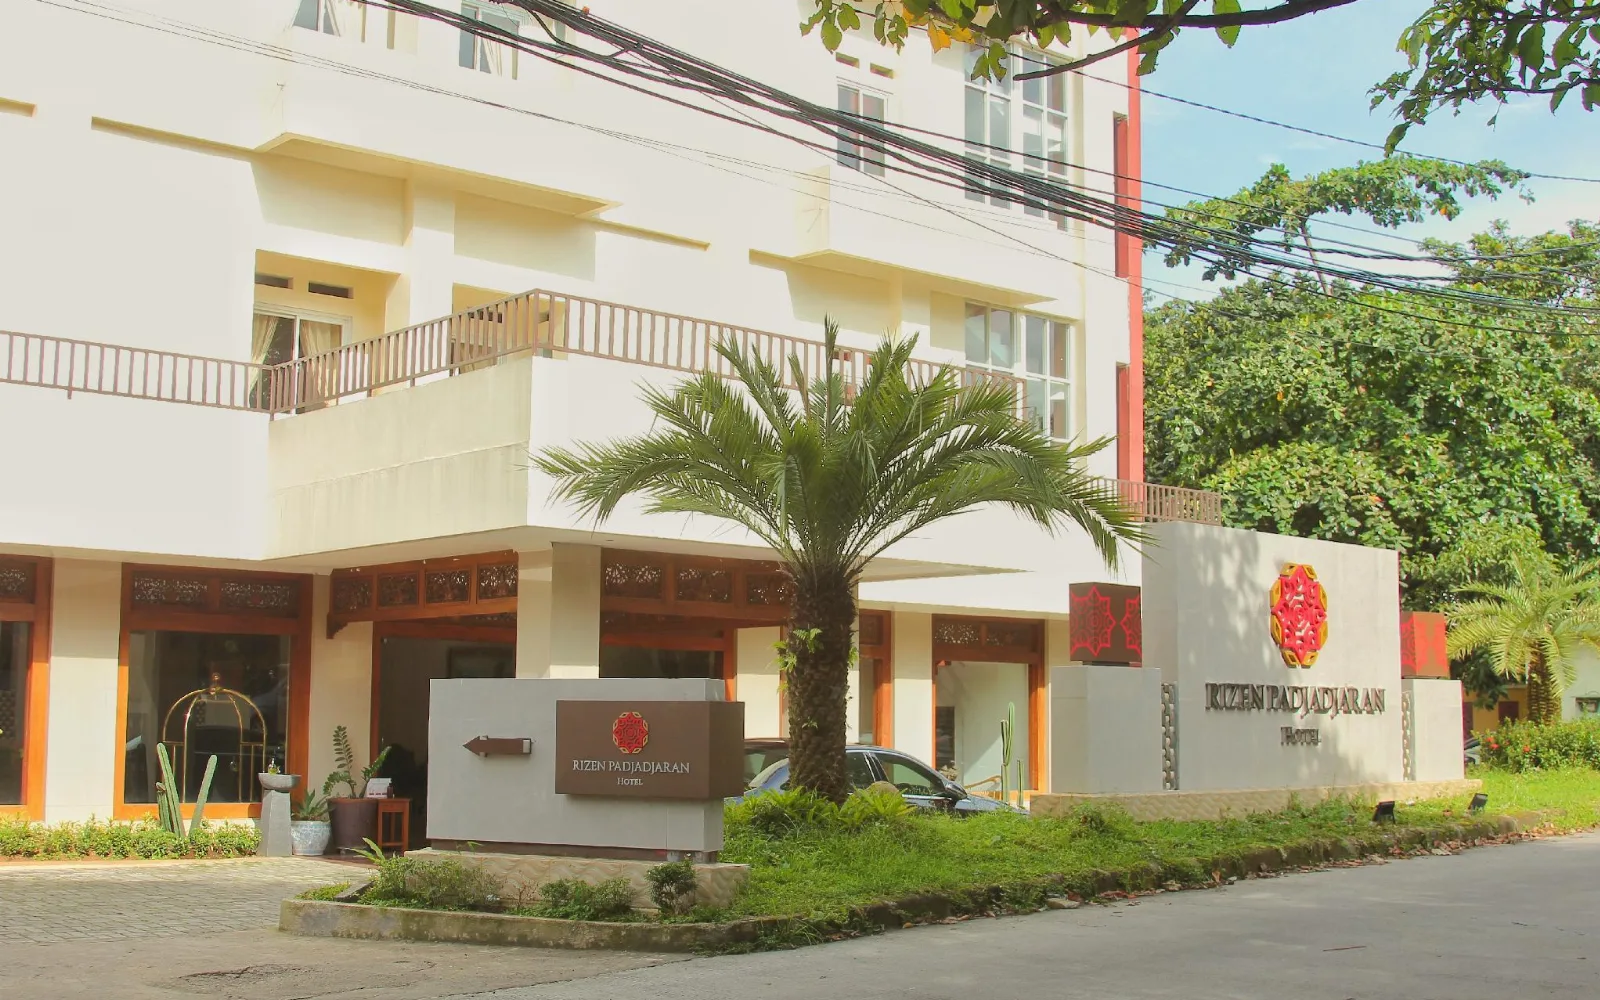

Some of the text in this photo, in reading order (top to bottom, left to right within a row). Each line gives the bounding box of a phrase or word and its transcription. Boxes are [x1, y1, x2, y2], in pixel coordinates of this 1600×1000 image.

[1205, 683, 1386, 720] RIZEN PADJADJARAN
[572, 760, 690, 774] RIZEN PADJADJARAN
[617, 777, 643, 786] HOTEL
